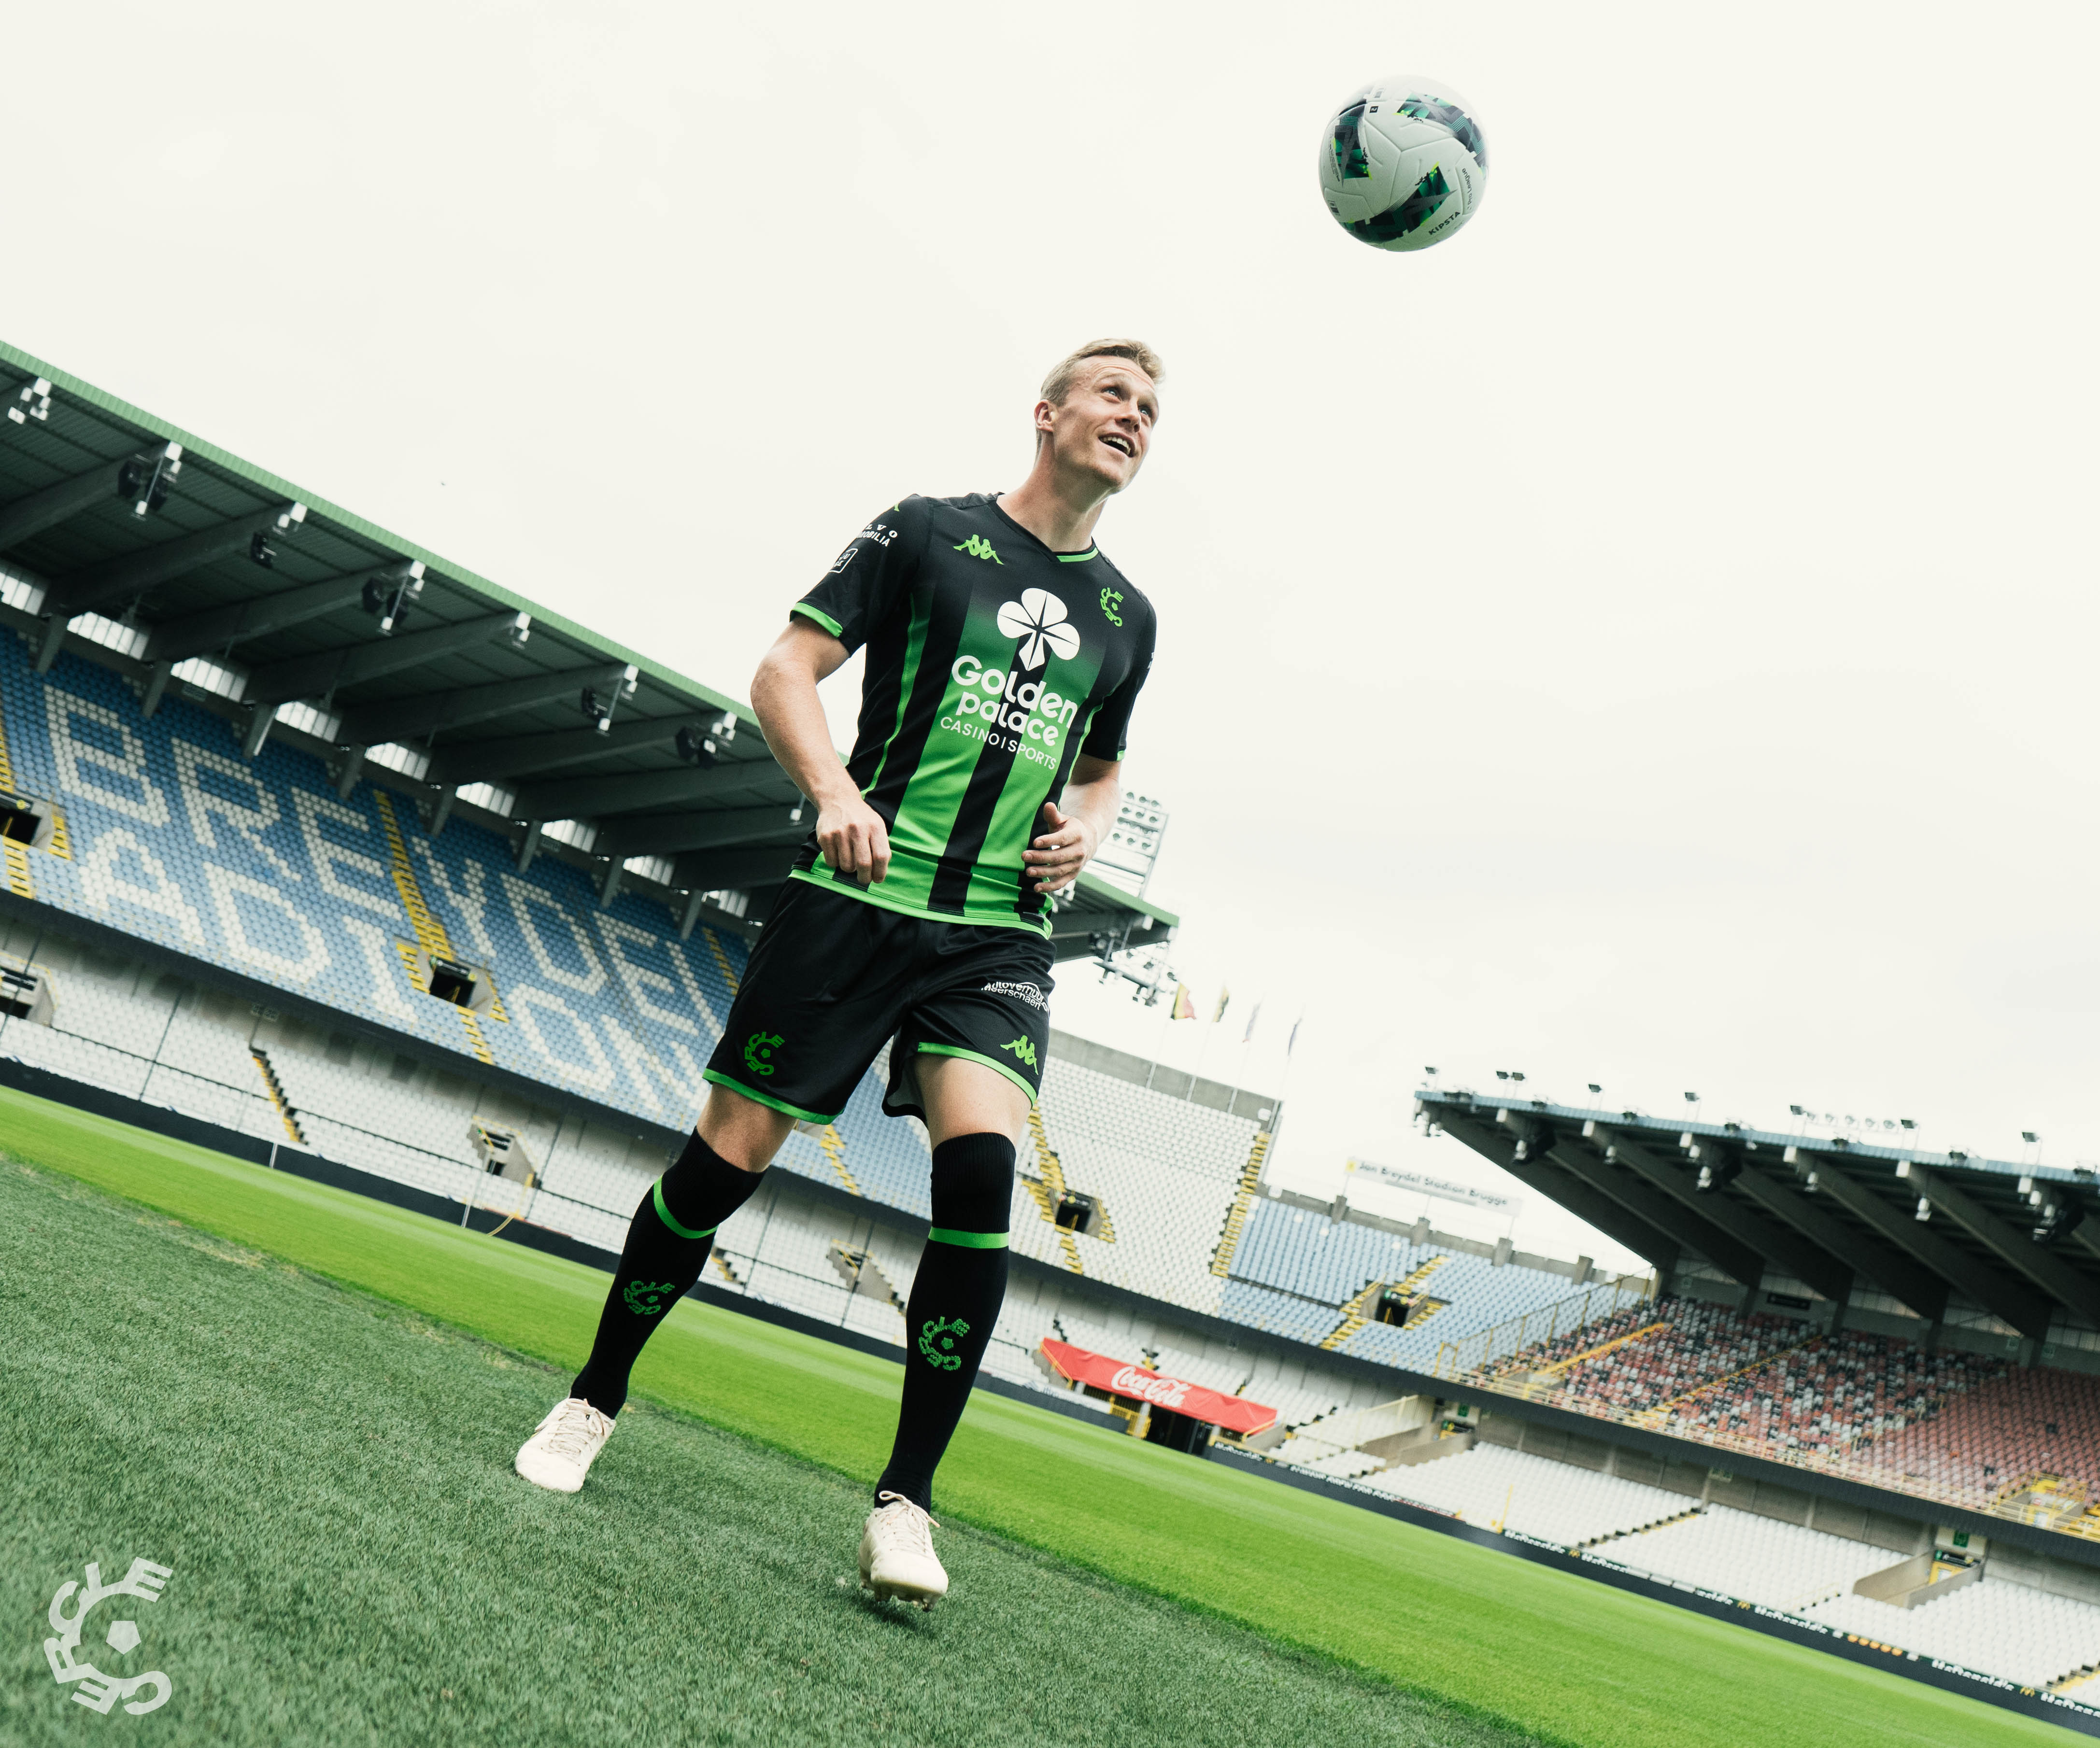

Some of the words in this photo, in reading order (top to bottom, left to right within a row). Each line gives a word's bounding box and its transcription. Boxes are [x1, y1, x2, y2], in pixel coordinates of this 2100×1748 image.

[1461, 168, 1472, 194] League
[1428, 211, 1461, 235] KIPSTA
[951, 655, 1078, 728] Golden
[955, 691, 1059, 746] palace
[1381, 1167, 1421, 1183] Breydel
[1424, 1177, 1465, 1194] Stadion
[1469, 1189, 1508, 1206] Brugge
[1111, 1366, 1192, 1408] Coca-Cola
